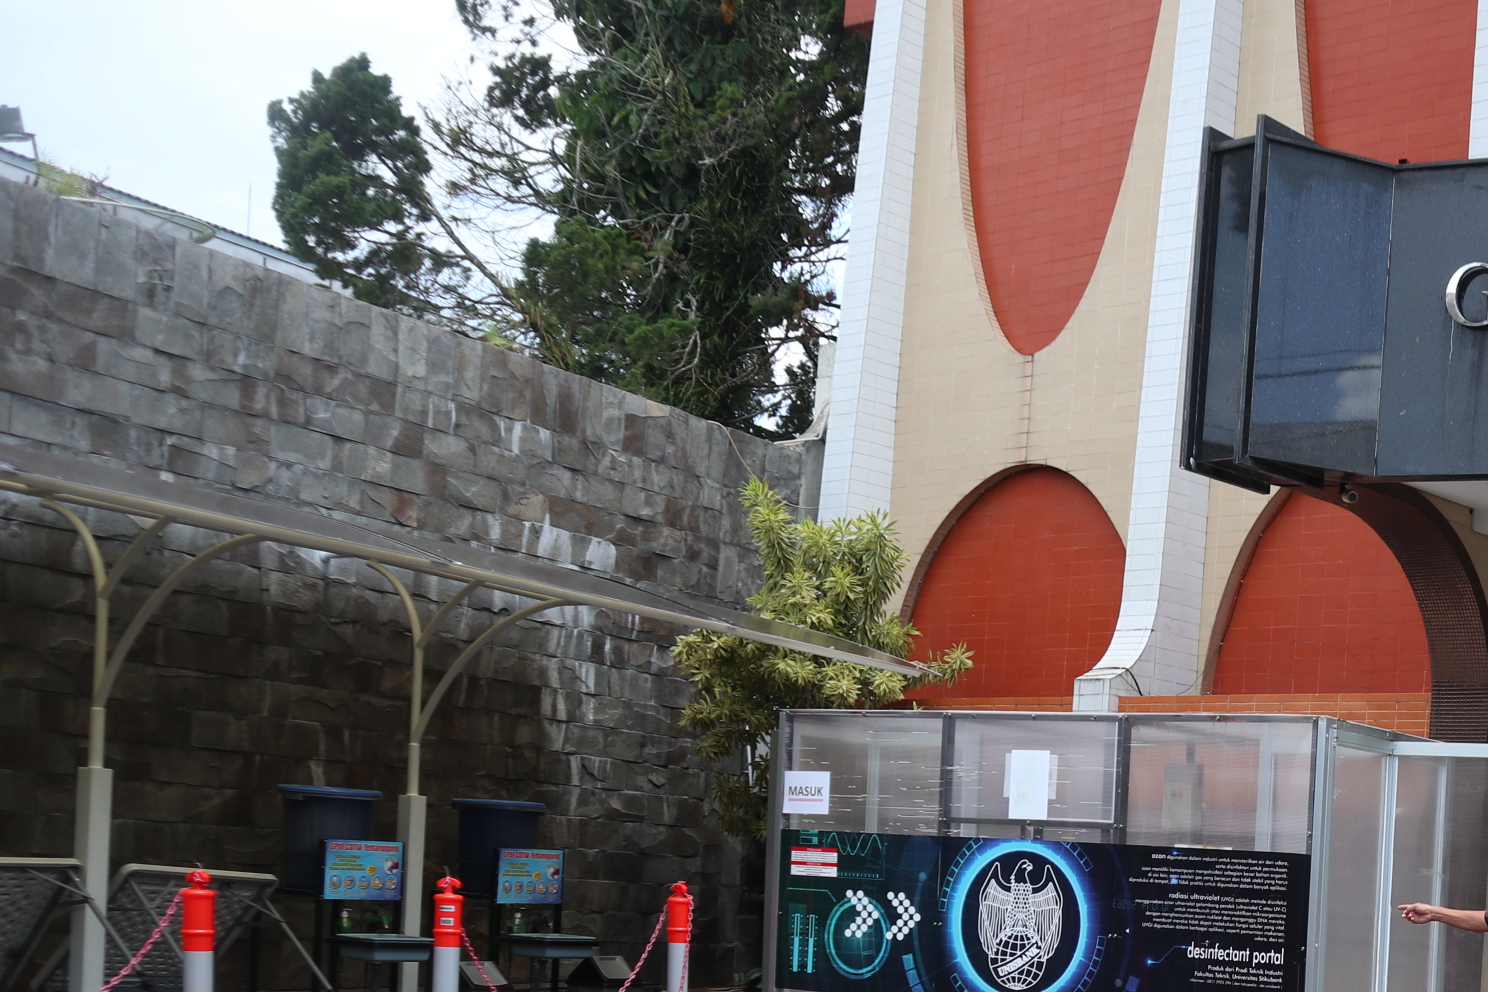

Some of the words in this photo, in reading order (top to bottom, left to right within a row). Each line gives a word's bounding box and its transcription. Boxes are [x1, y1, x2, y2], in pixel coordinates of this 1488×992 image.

[788, 786, 823, 796] MASUK
[1187, 941, 1249, 962] desinfectant
[1253, 948, 1284, 967] portal
